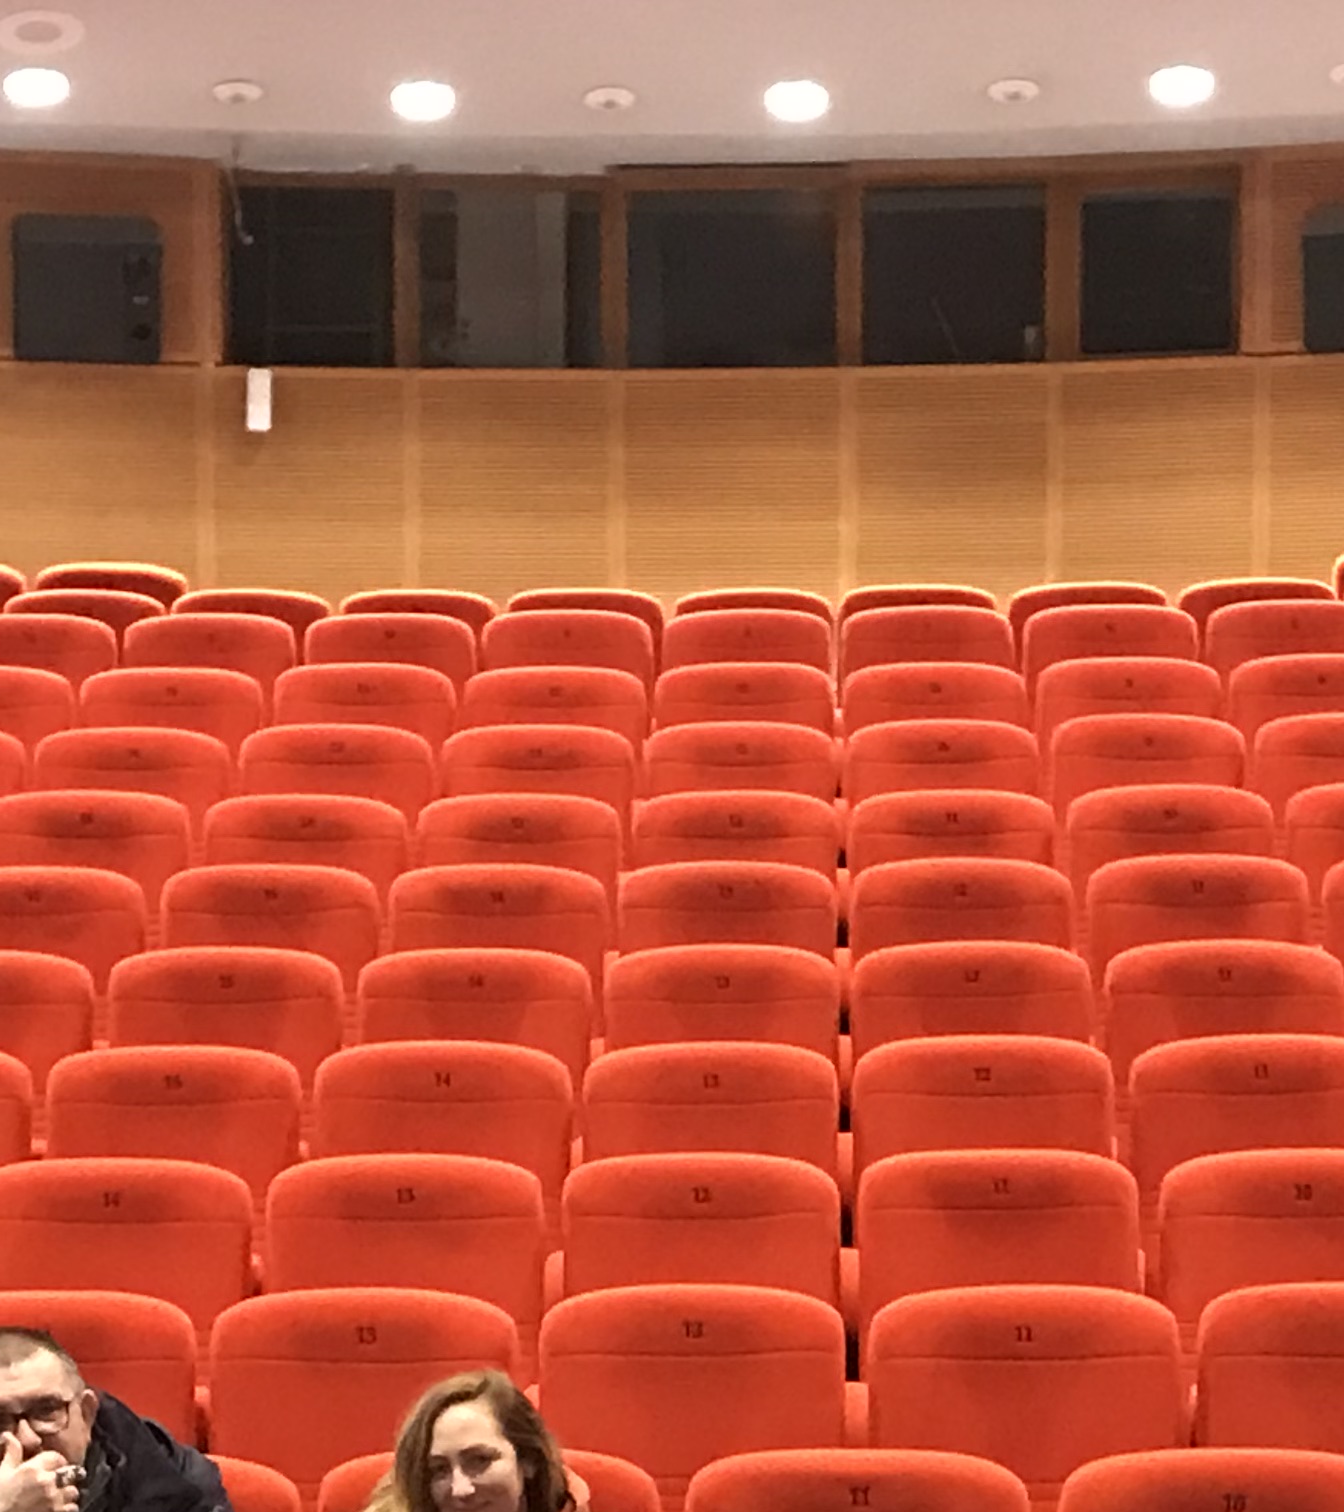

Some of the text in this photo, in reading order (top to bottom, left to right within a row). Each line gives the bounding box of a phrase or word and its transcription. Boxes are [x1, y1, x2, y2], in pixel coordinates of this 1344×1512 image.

[1015, 1325, 1033, 1343] 11
[848, 1484, 871, 1506] 11
[1222, 1492, 1247, 1512] 10
